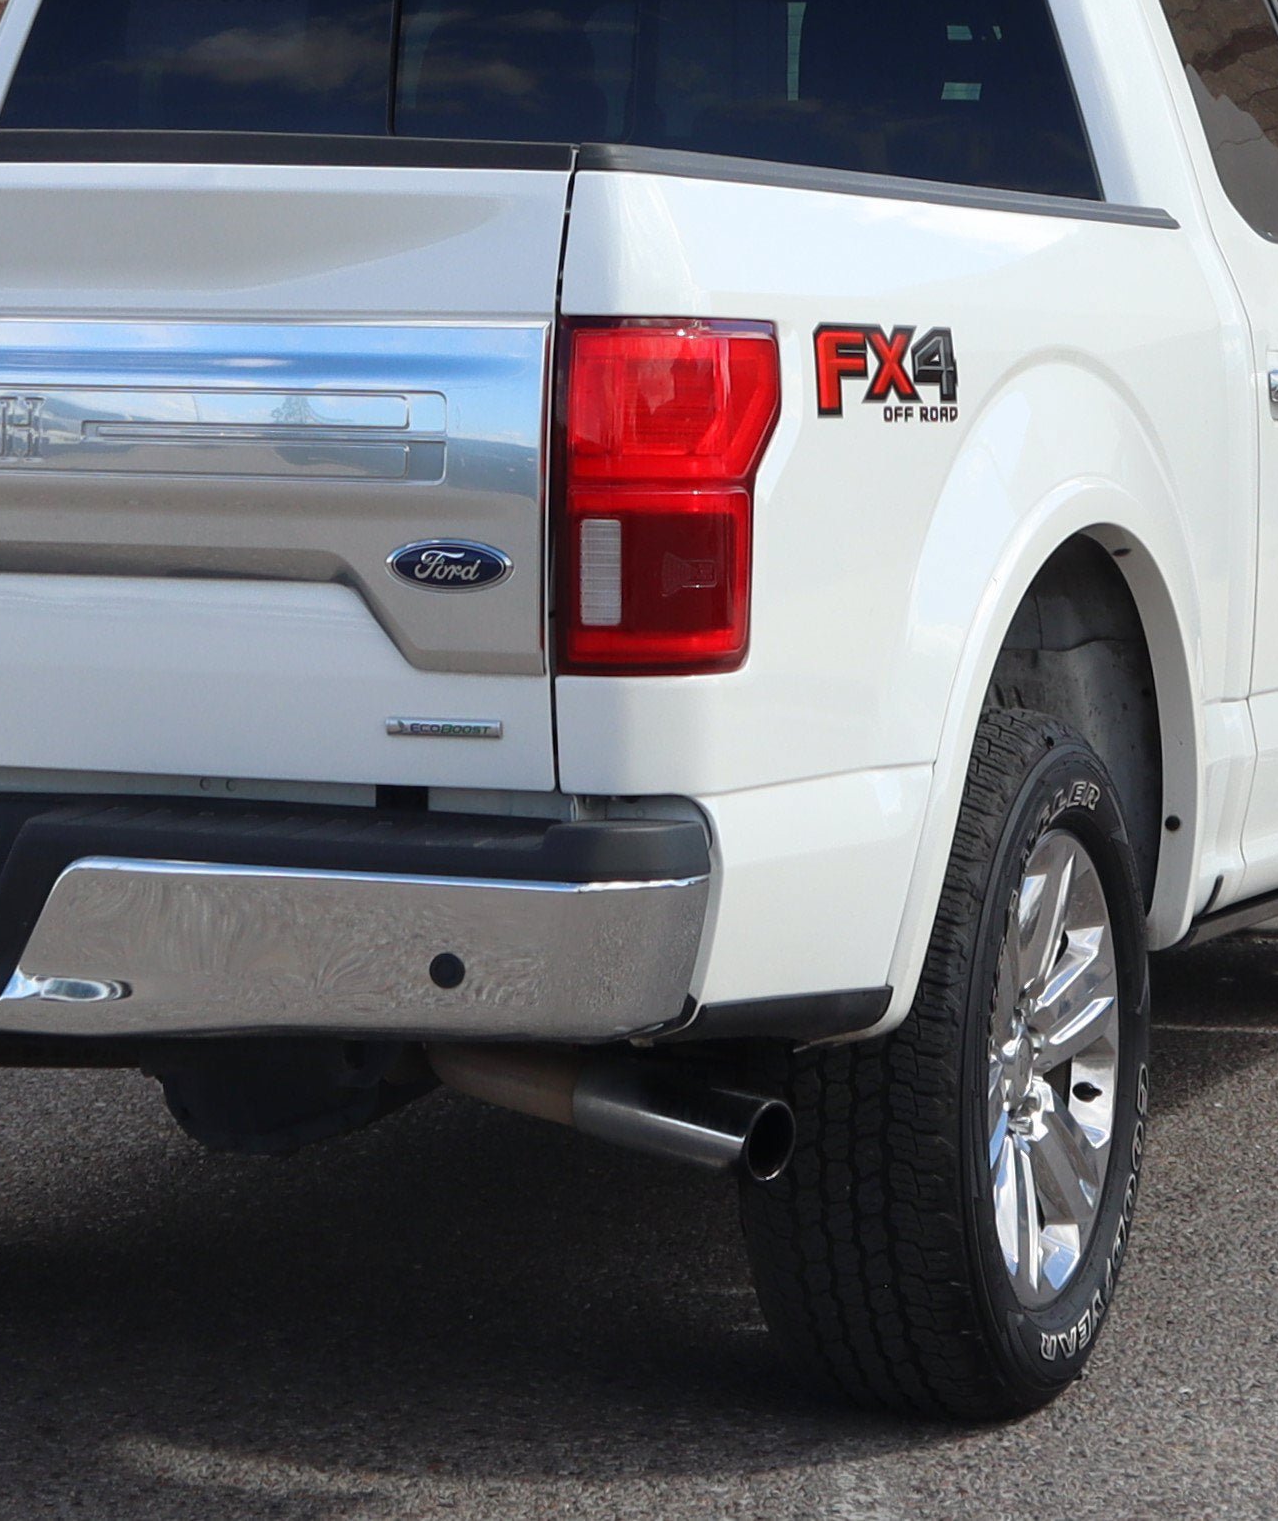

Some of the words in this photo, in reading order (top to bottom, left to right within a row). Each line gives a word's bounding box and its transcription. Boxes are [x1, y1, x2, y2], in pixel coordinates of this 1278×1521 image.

[812, 320, 959, 420] FX4
[883, 405, 915, 423] OFF
[919, 405, 959, 423] ROAD
[414, 549, 482, 581] Ford
[1040, 1062, 1150, 1362] GOODYEAR
